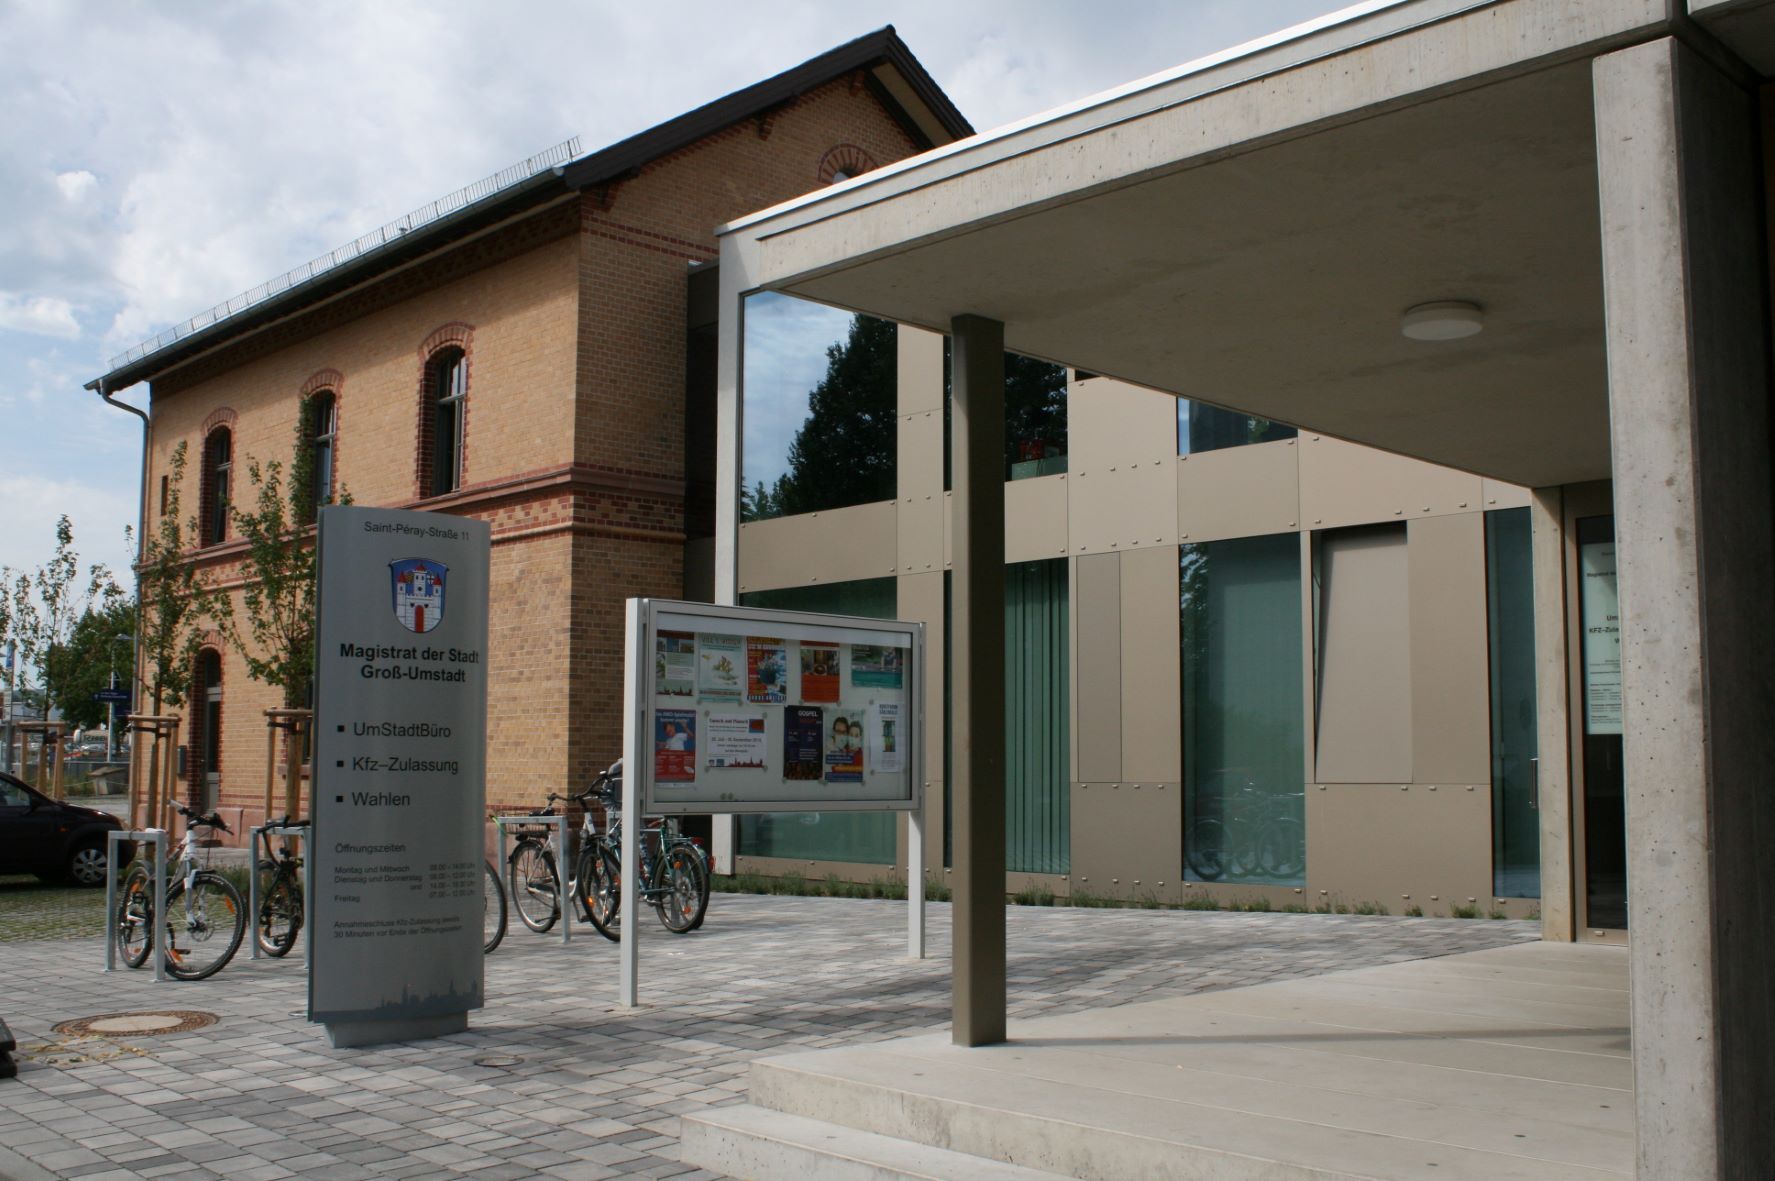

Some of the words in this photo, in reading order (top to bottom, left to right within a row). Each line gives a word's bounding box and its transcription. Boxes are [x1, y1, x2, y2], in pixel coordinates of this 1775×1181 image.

[364, 521, 458, 540] Saint-Péray-Straße
[461, 531, 470, 540] 11
[340, 643, 417, 662] Magistrat
[421, 647, 445, 661] der
[448, 648, 479, 664] Stadt
[361, 664, 465, 682] Groß-Umstadt
[353, 721, 451, 738] UmStadtBüro
[352, 757, 459, 775] Kfz-Zulassung
[352, 792, 410, 806] Wahlen
[335, 843, 406, 855] Öffnungszeiten
[334, 866, 363, 874] Montag
[380, 865, 410, 873] Mittwoch
[334, 875, 367, 884] Dienstag
[384, 875, 423, 883] Donnerstag
[334, 895, 361, 903] Freitag
[334, 930, 343, 938] 30
[345, 929, 375, 938] Minuten
